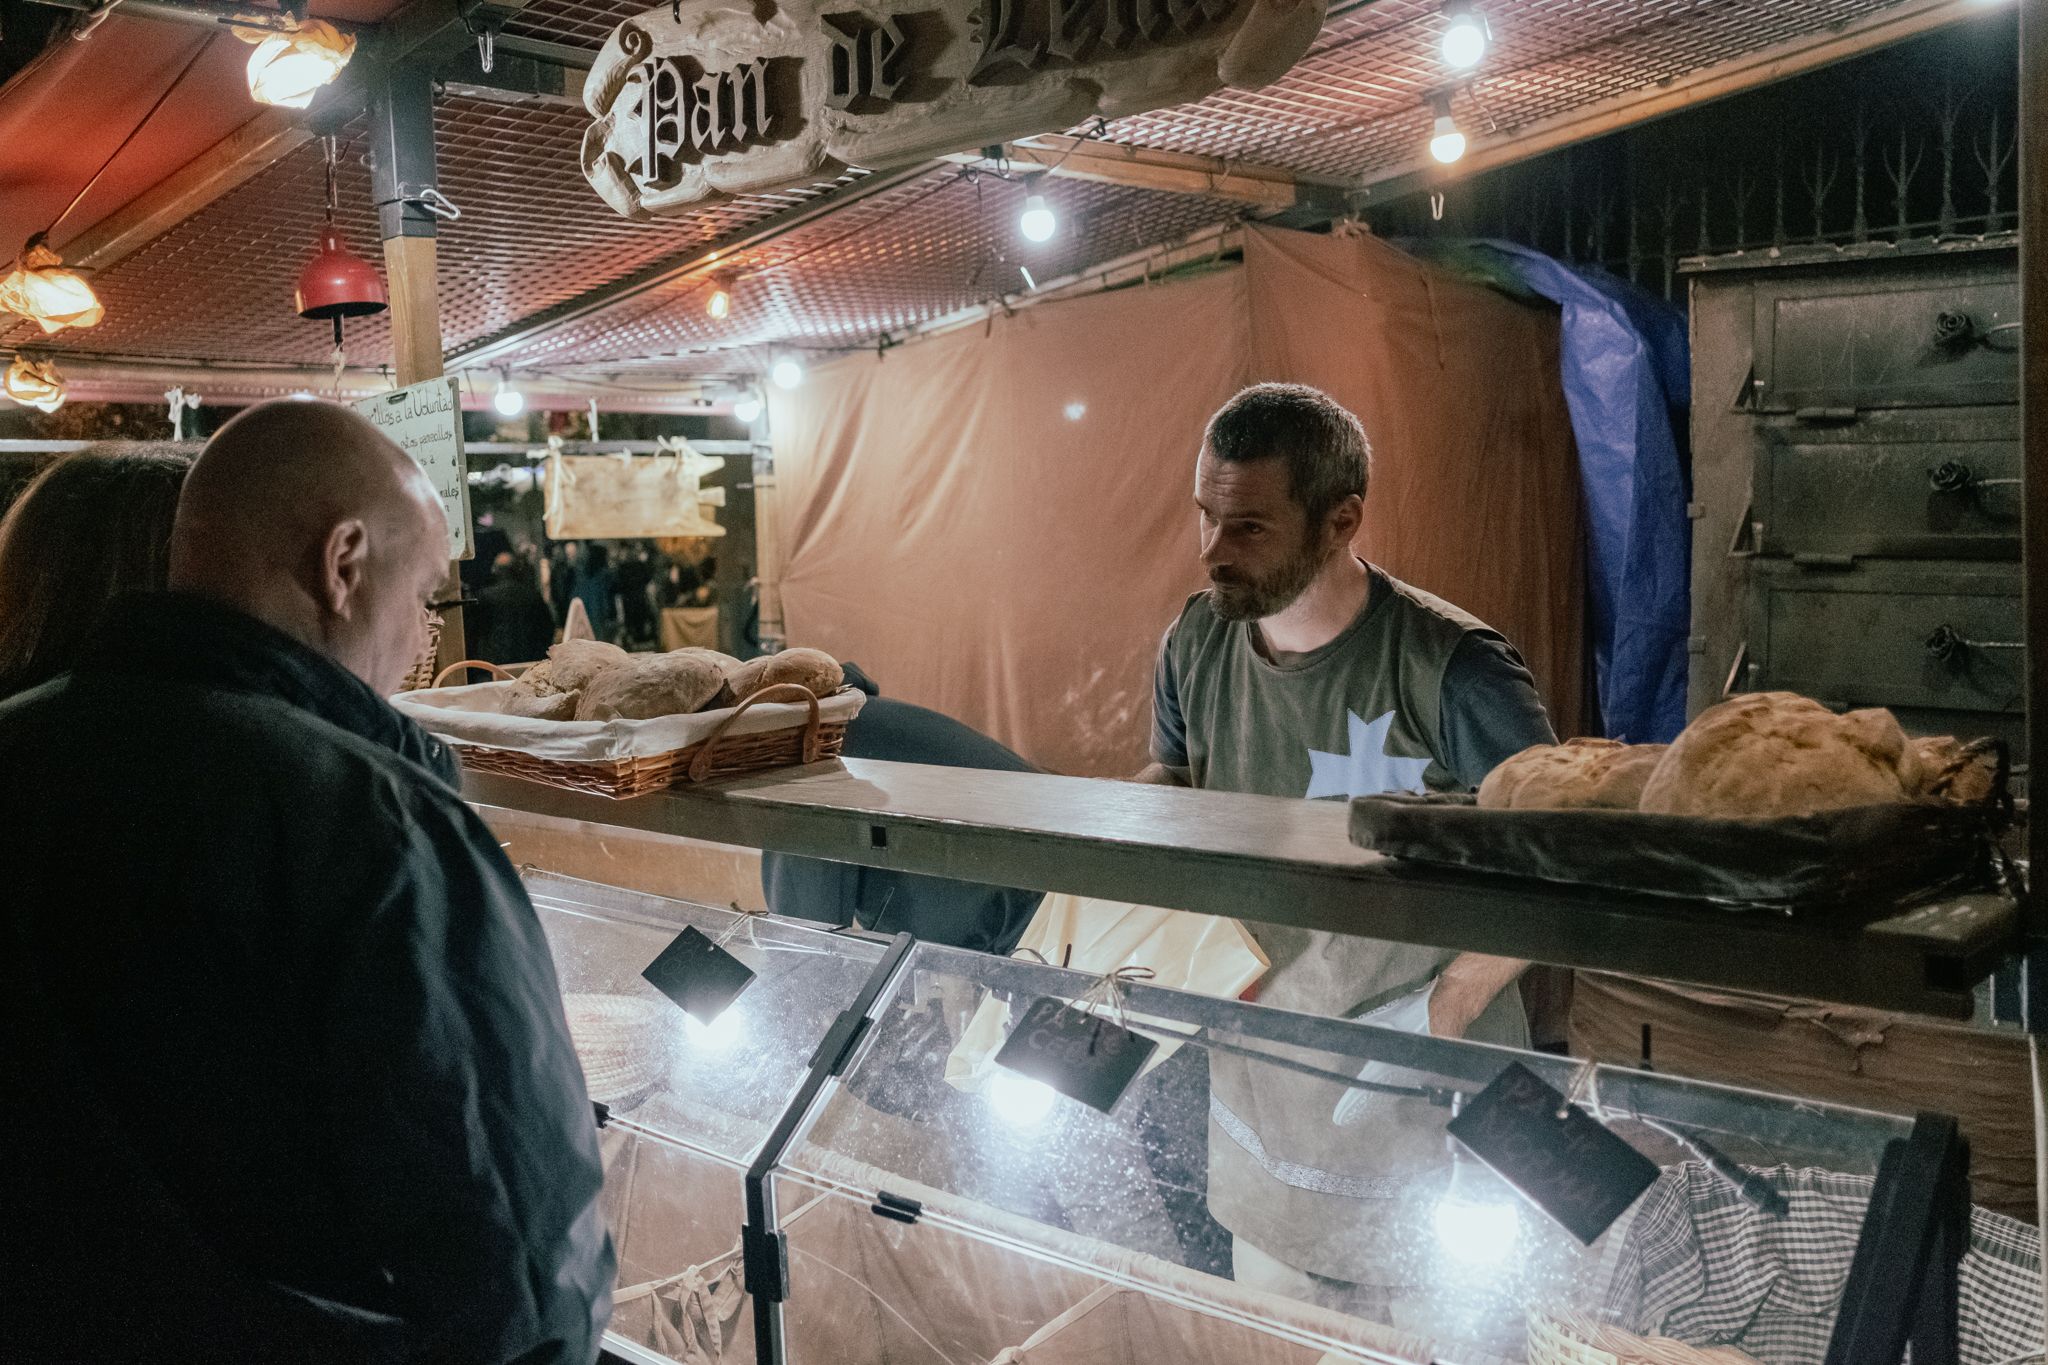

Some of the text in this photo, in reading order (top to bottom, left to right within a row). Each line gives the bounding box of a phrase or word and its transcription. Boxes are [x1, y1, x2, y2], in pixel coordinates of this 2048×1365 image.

[626, 56, 773, 187] Pan
[821, 14, 905, 111] de
[404, 401, 413, 419] la
[411, 384, 453, 417] Voluntad
